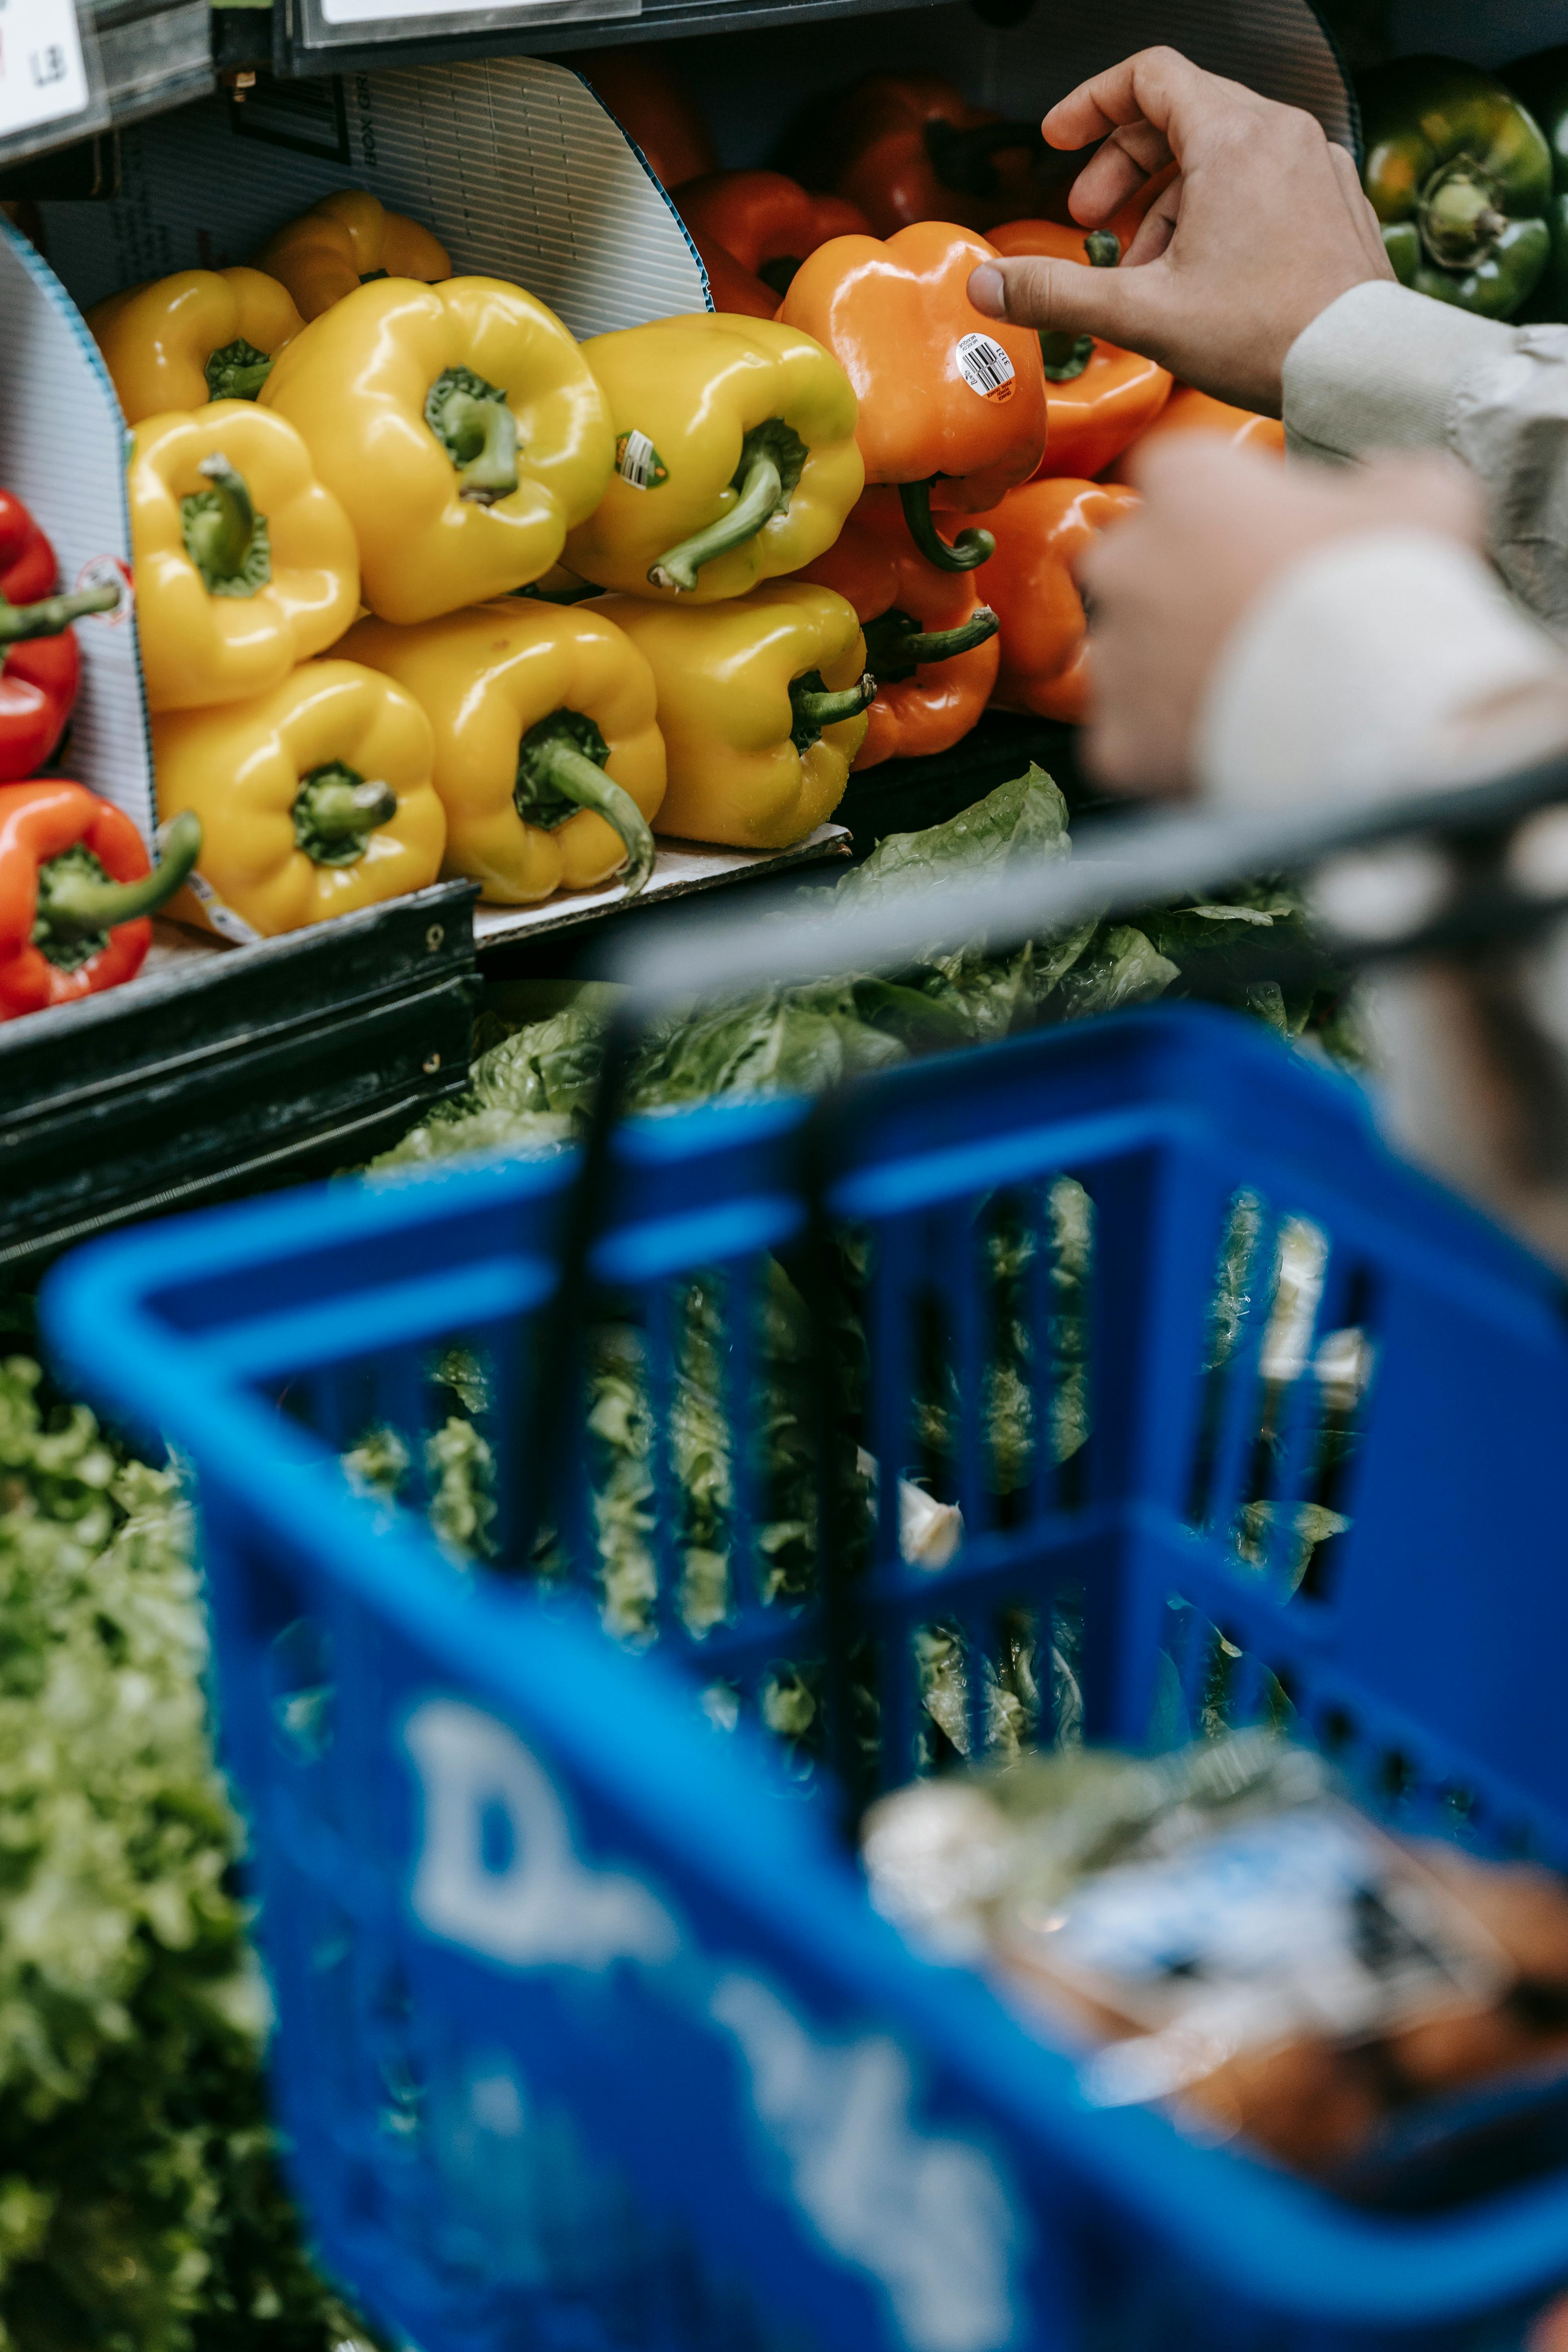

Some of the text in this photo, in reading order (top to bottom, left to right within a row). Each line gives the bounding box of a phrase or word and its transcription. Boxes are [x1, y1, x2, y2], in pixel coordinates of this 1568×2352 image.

[361, 118, 376, 166] BOX
[958, 334, 976, 348] MEXIQUE
[996, 348, 1010, 366] 3121
[987, 387, 1000, 398] ORANGE
[998, 390, 1011, 401] ORANGE
